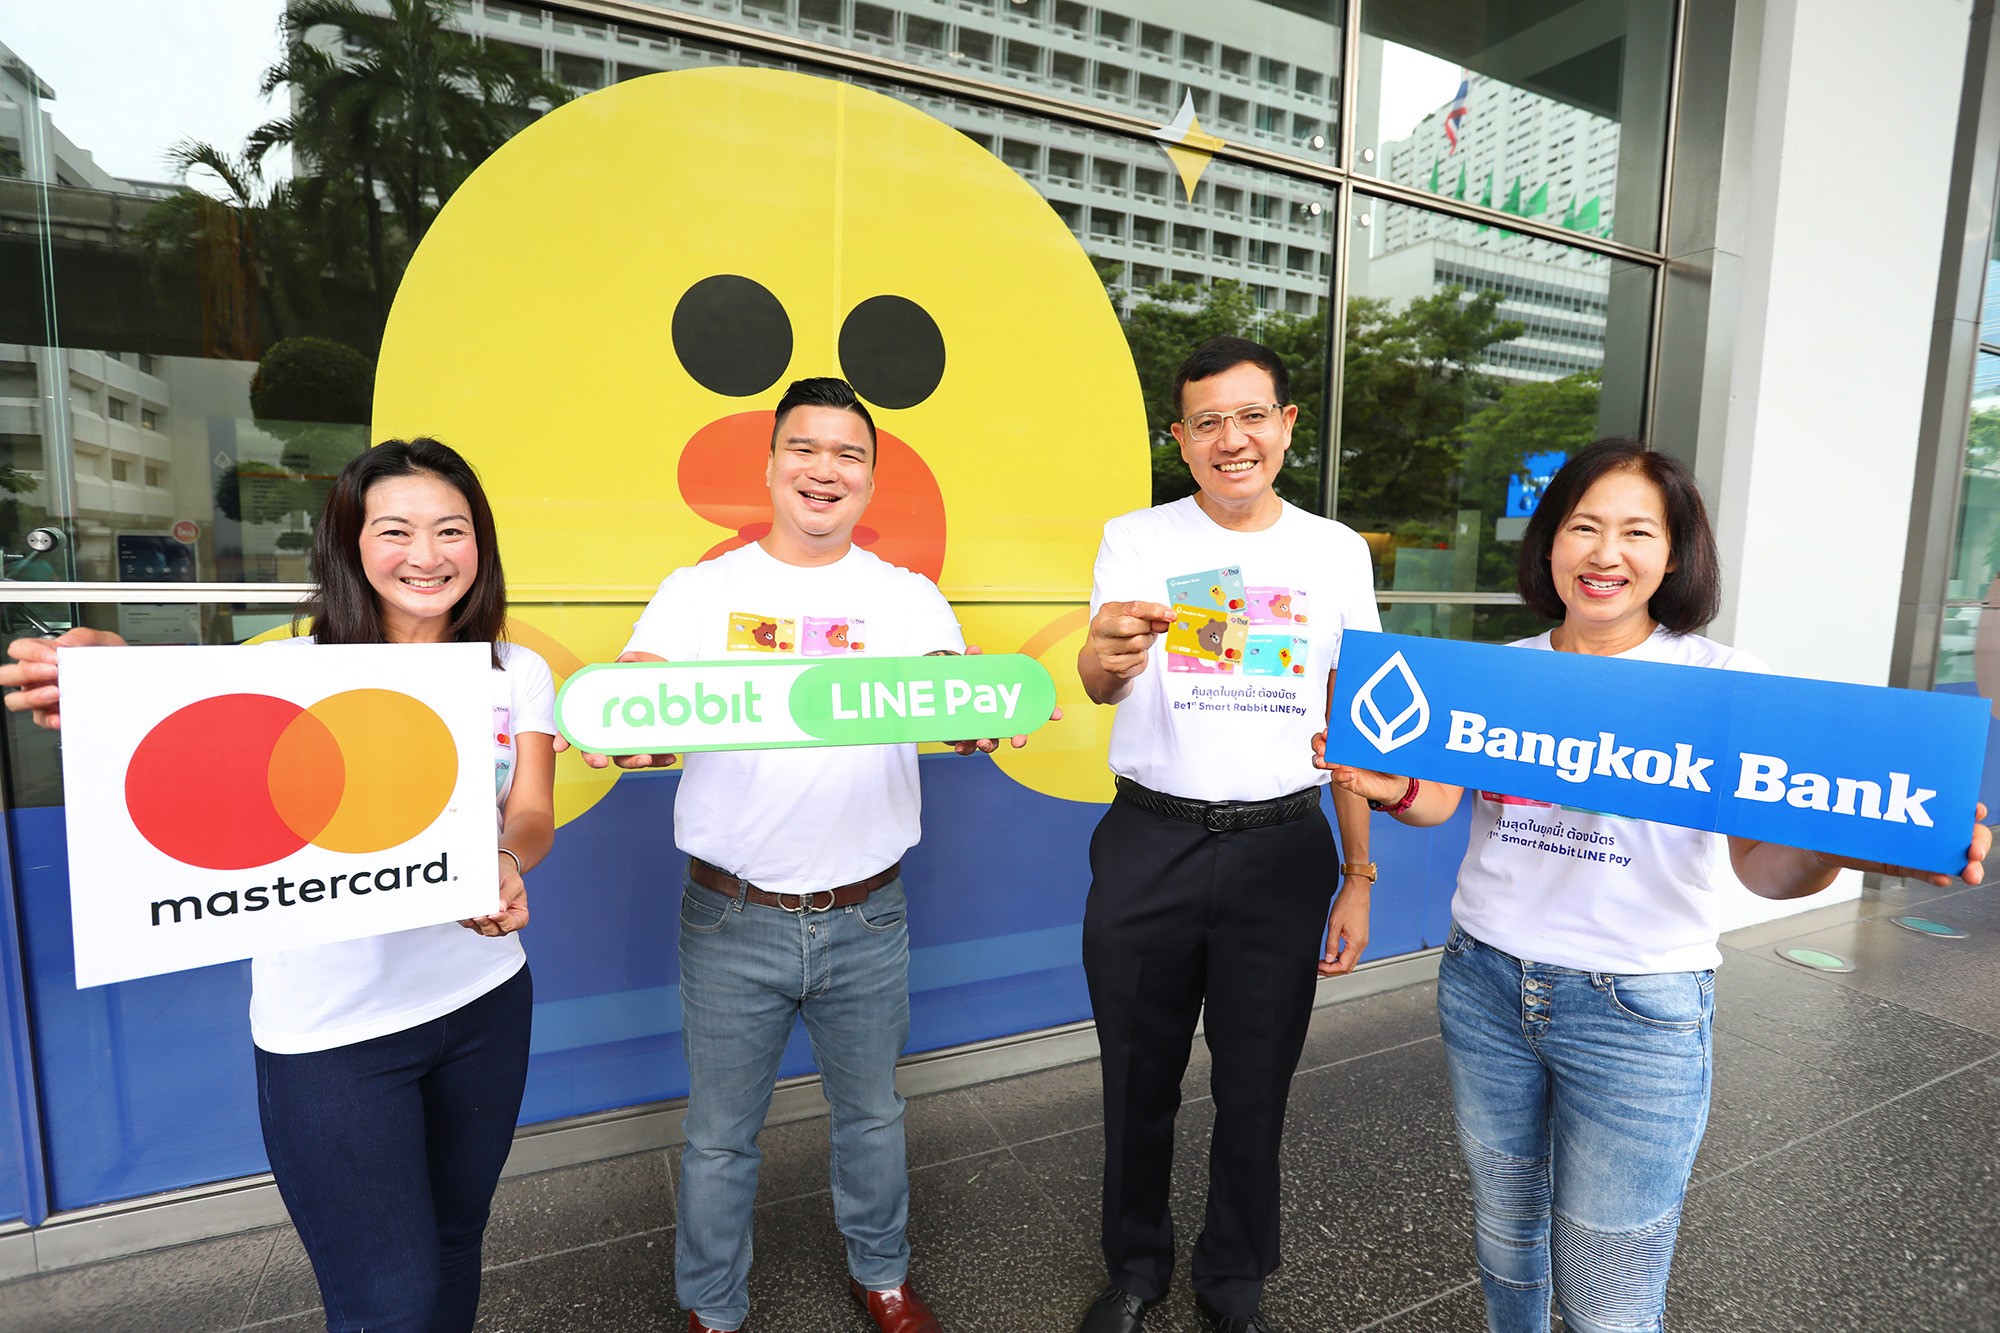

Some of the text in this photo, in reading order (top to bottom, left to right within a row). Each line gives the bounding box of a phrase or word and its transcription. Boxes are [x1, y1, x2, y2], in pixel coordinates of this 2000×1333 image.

[602, 679, 1022, 728] rabbit LINE Pay
[1258, 687, 1297, 700] ต้องบัตร
[1199, 702, 1231, 711] Smart
[1233, 703, 1268, 712] Rabbit
[1270, 704, 1291, 714] LINE
[1292, 705, 1307, 716] Pay
[1445, 709, 1937, 828] Bangkok Bank
[1566, 827, 1615, 846] ต้องบัตร
[1501, 833, 1537, 849] Smart
[1537, 840, 1575, 857] Rabbit
[1577, 846, 1606, 863] LINE
[1609, 853, 1632, 867] Pay
